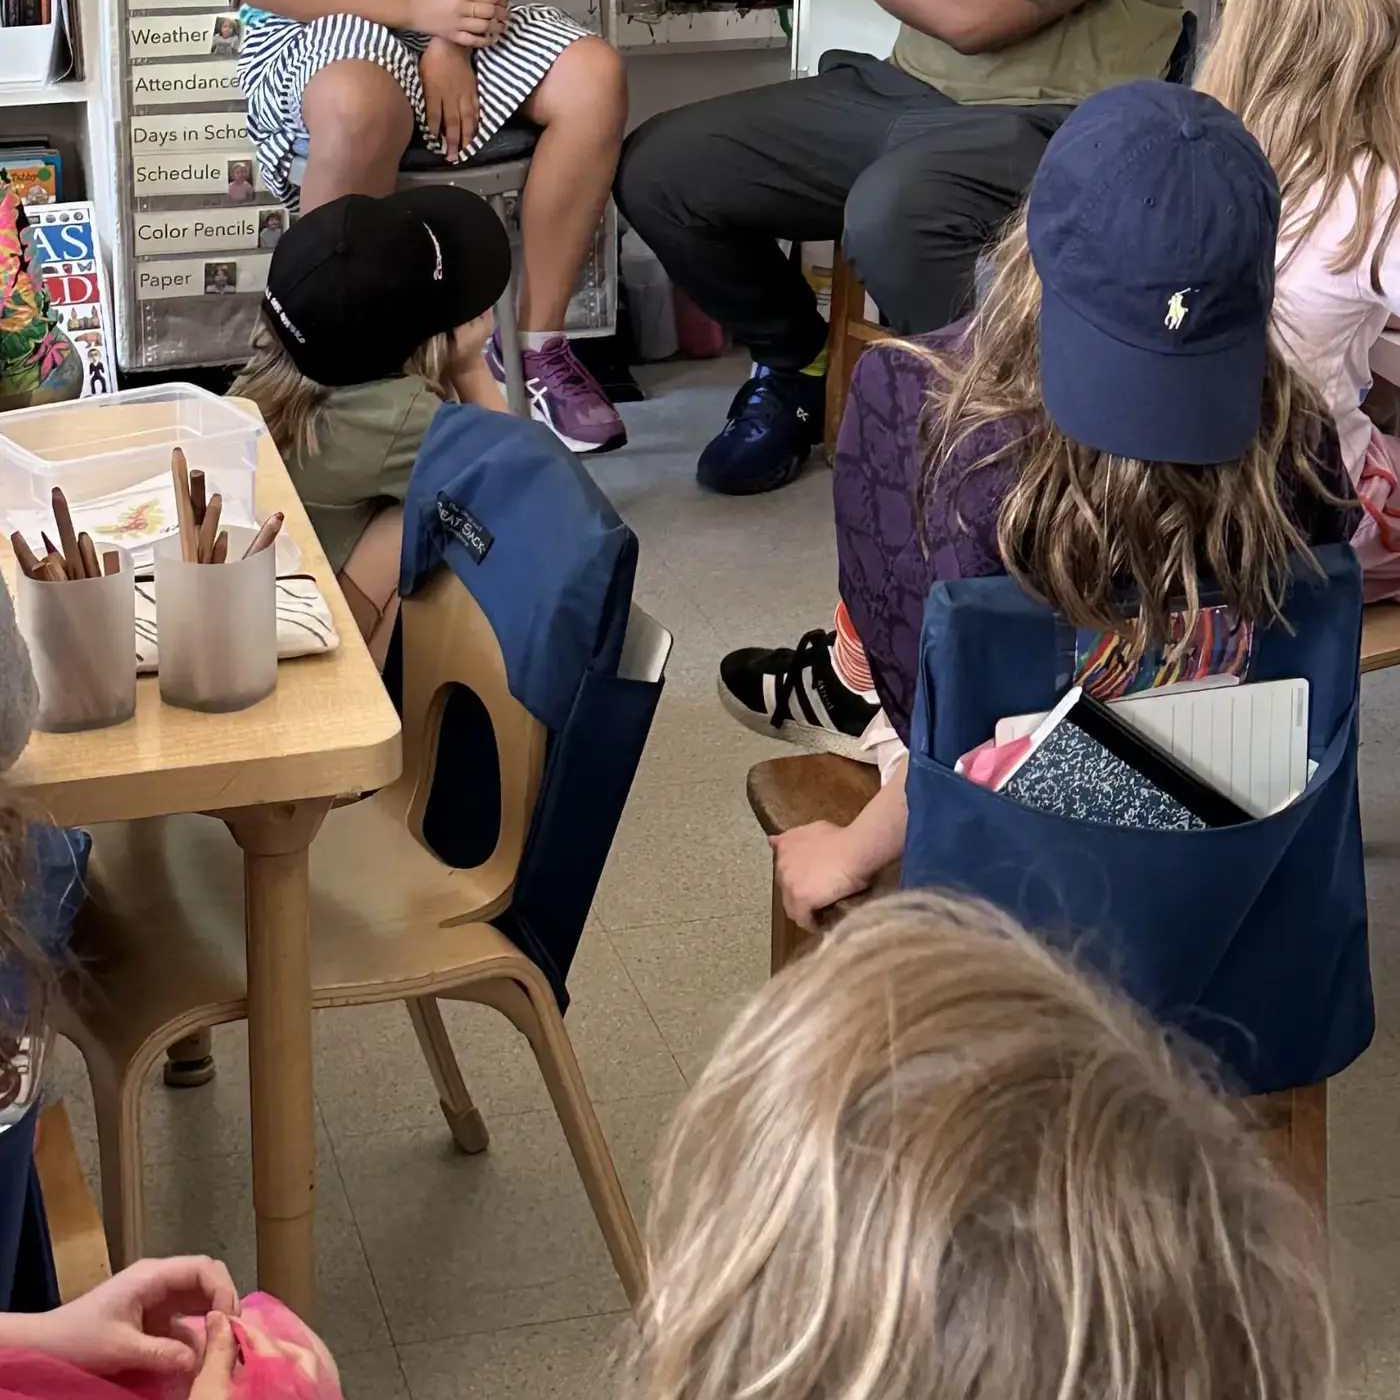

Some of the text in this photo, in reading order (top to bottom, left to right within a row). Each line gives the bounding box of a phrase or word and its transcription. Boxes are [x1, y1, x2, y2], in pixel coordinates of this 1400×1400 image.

[131, 26, 209, 46] Weather
[134, 74, 240, 93] Attendance
[133, 123, 247, 147] Days in Scho
[136, 164, 221, 183] Schedule
[137, 219, 255, 242] Color Pencils
[139, 272, 193, 291] Paper
